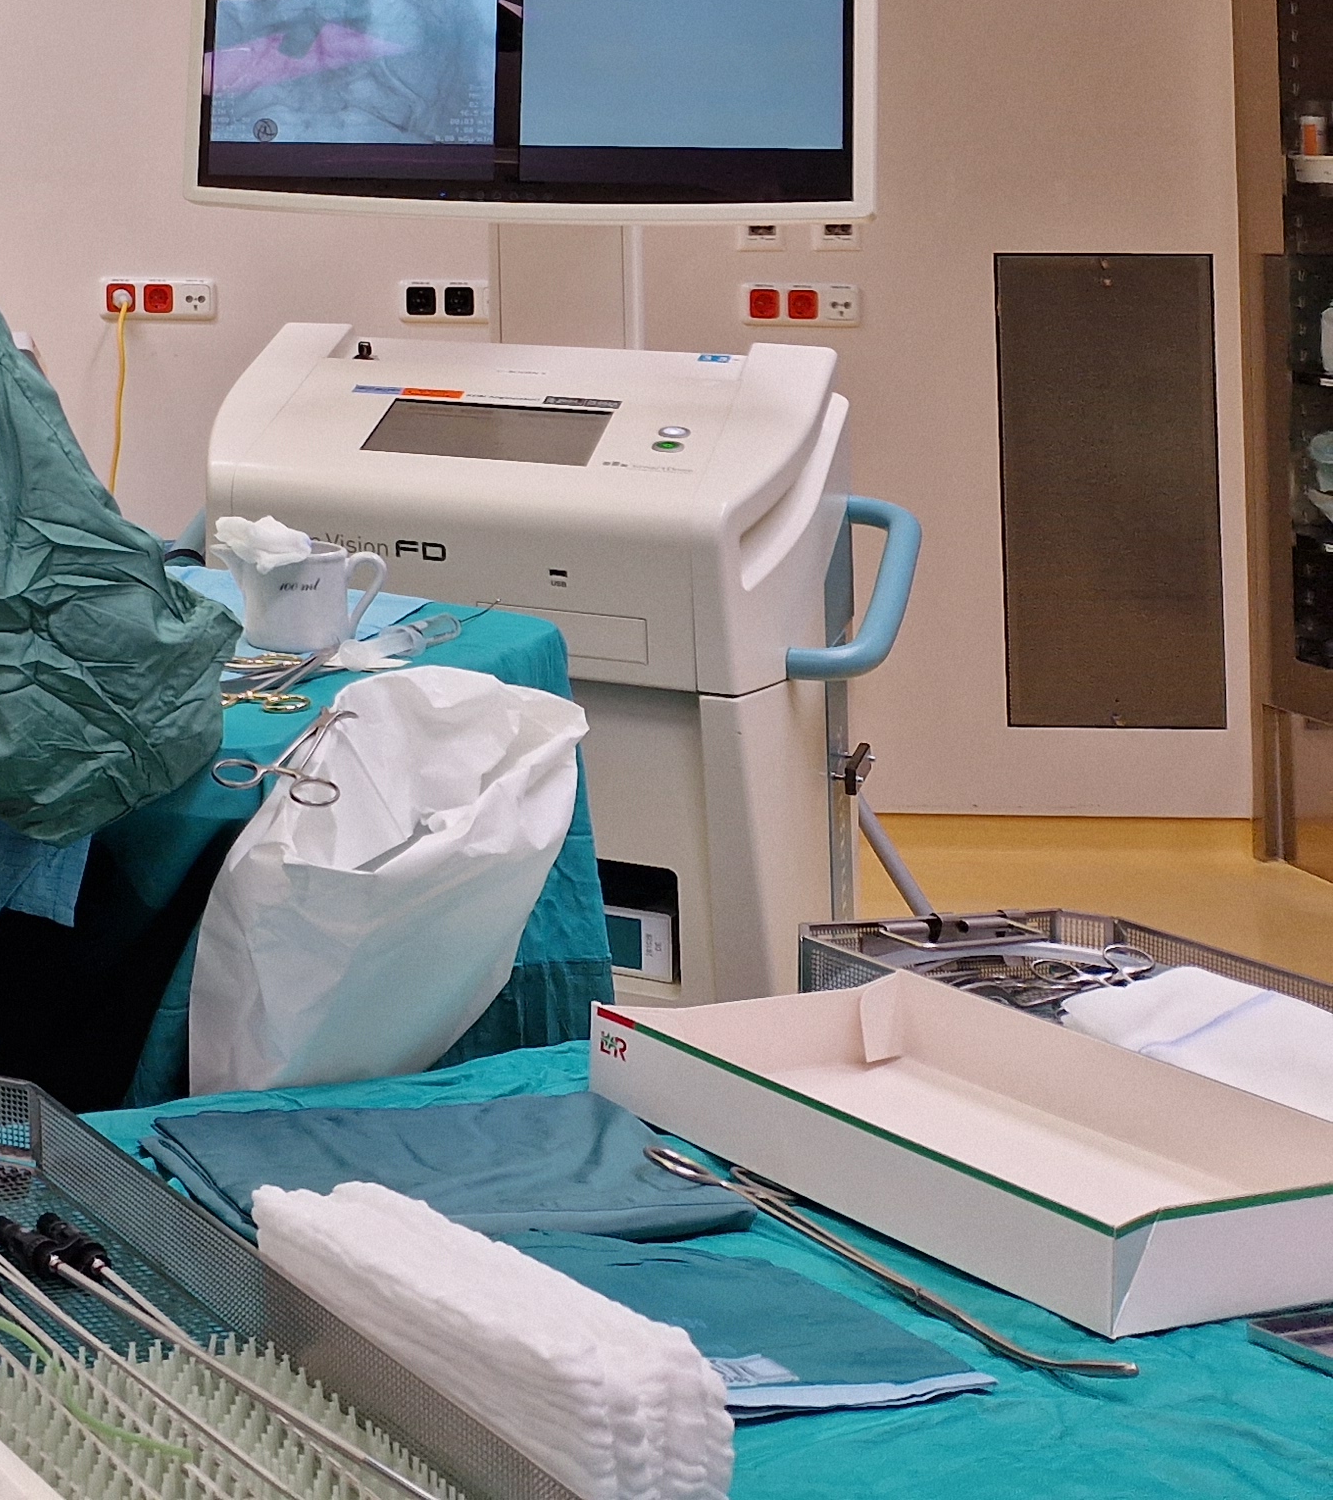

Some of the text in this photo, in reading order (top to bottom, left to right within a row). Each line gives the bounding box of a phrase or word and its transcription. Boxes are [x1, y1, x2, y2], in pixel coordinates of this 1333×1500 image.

[326, 533, 447, 562] Vision FD
[280, 578, 321, 592] 100 ml
[550, 580, 567, 588] USB
